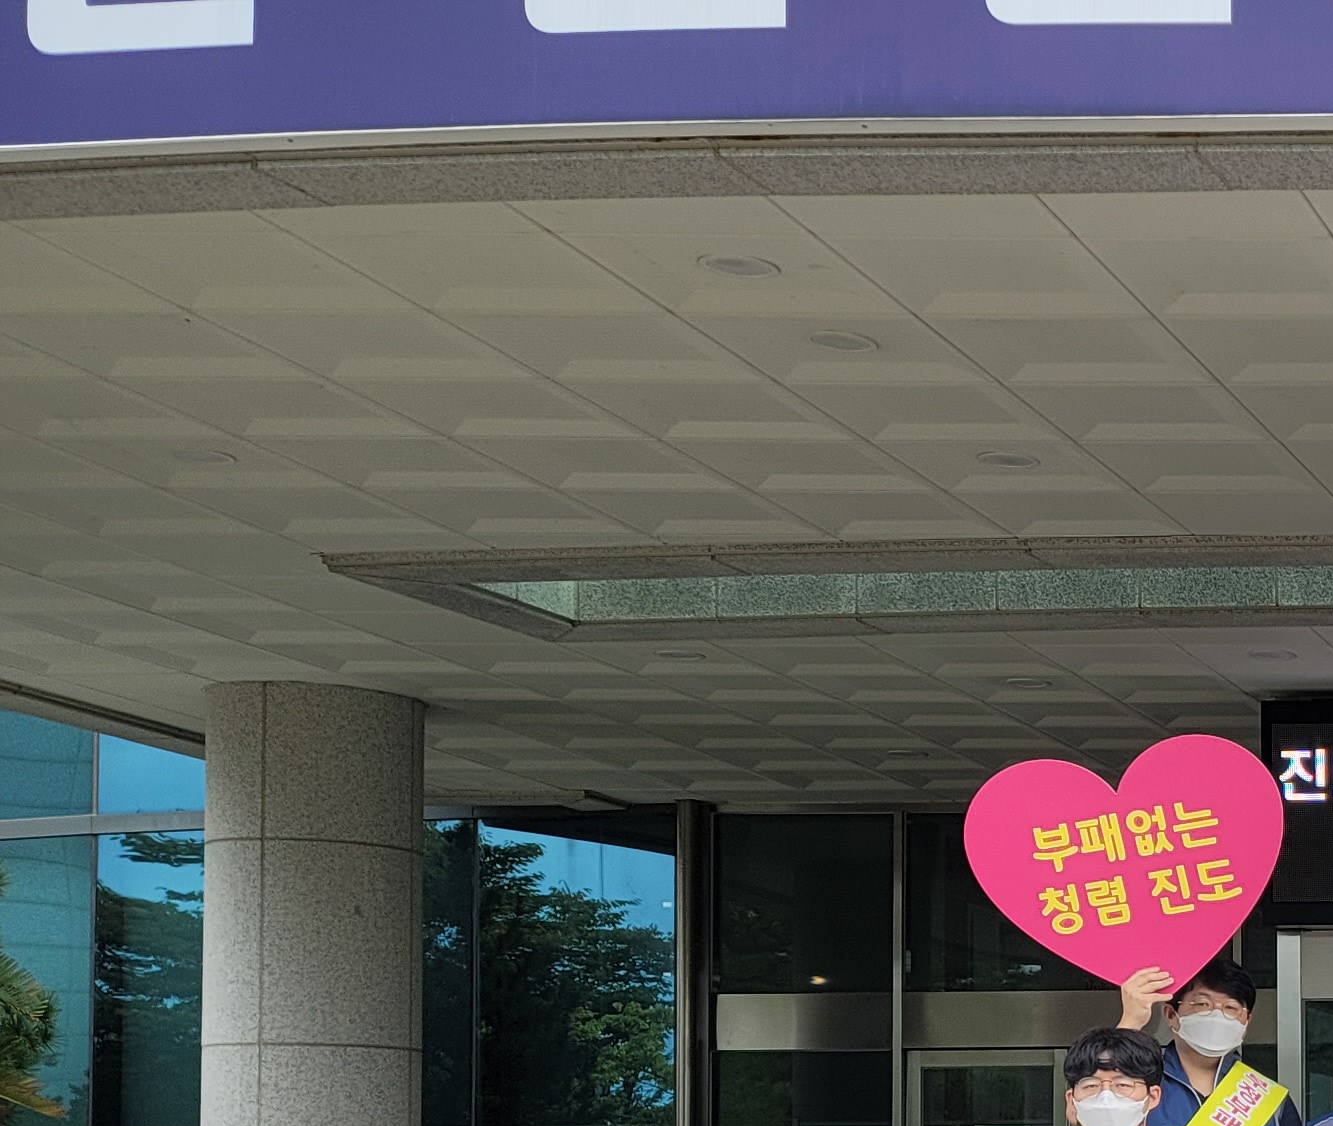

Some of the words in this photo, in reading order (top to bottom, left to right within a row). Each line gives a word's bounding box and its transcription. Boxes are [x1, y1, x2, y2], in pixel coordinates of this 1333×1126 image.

[1032, 801, 1219, 872] 부패없는
[1039, 876, 1131, 936] 청렴
[1148, 859, 1242, 915] 진도
